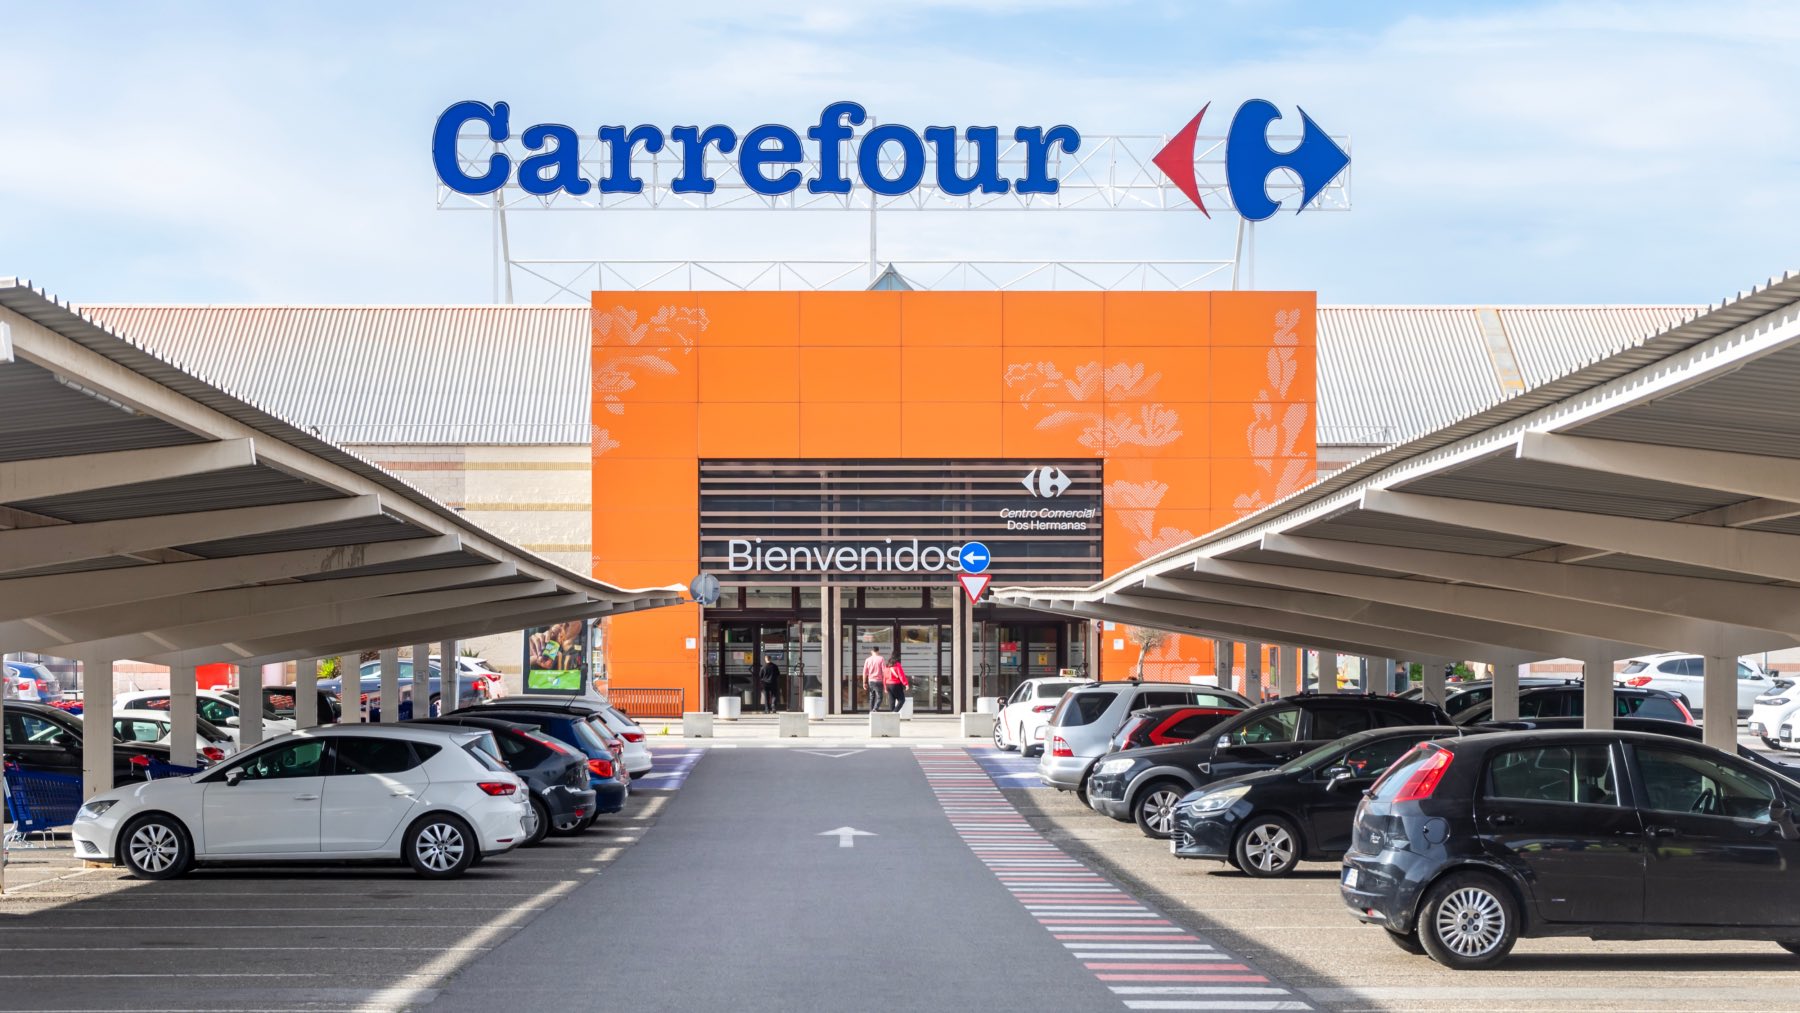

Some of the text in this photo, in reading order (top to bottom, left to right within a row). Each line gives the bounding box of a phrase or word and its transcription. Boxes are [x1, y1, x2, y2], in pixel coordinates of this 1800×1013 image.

[432, 100, 1081, 196] Carrefour
[999, 508, 1096, 518] Centro Comercial
[1007, 520, 1087, 530] Dos Hermanas
[728, 537, 963, 573] Bienvenidos
